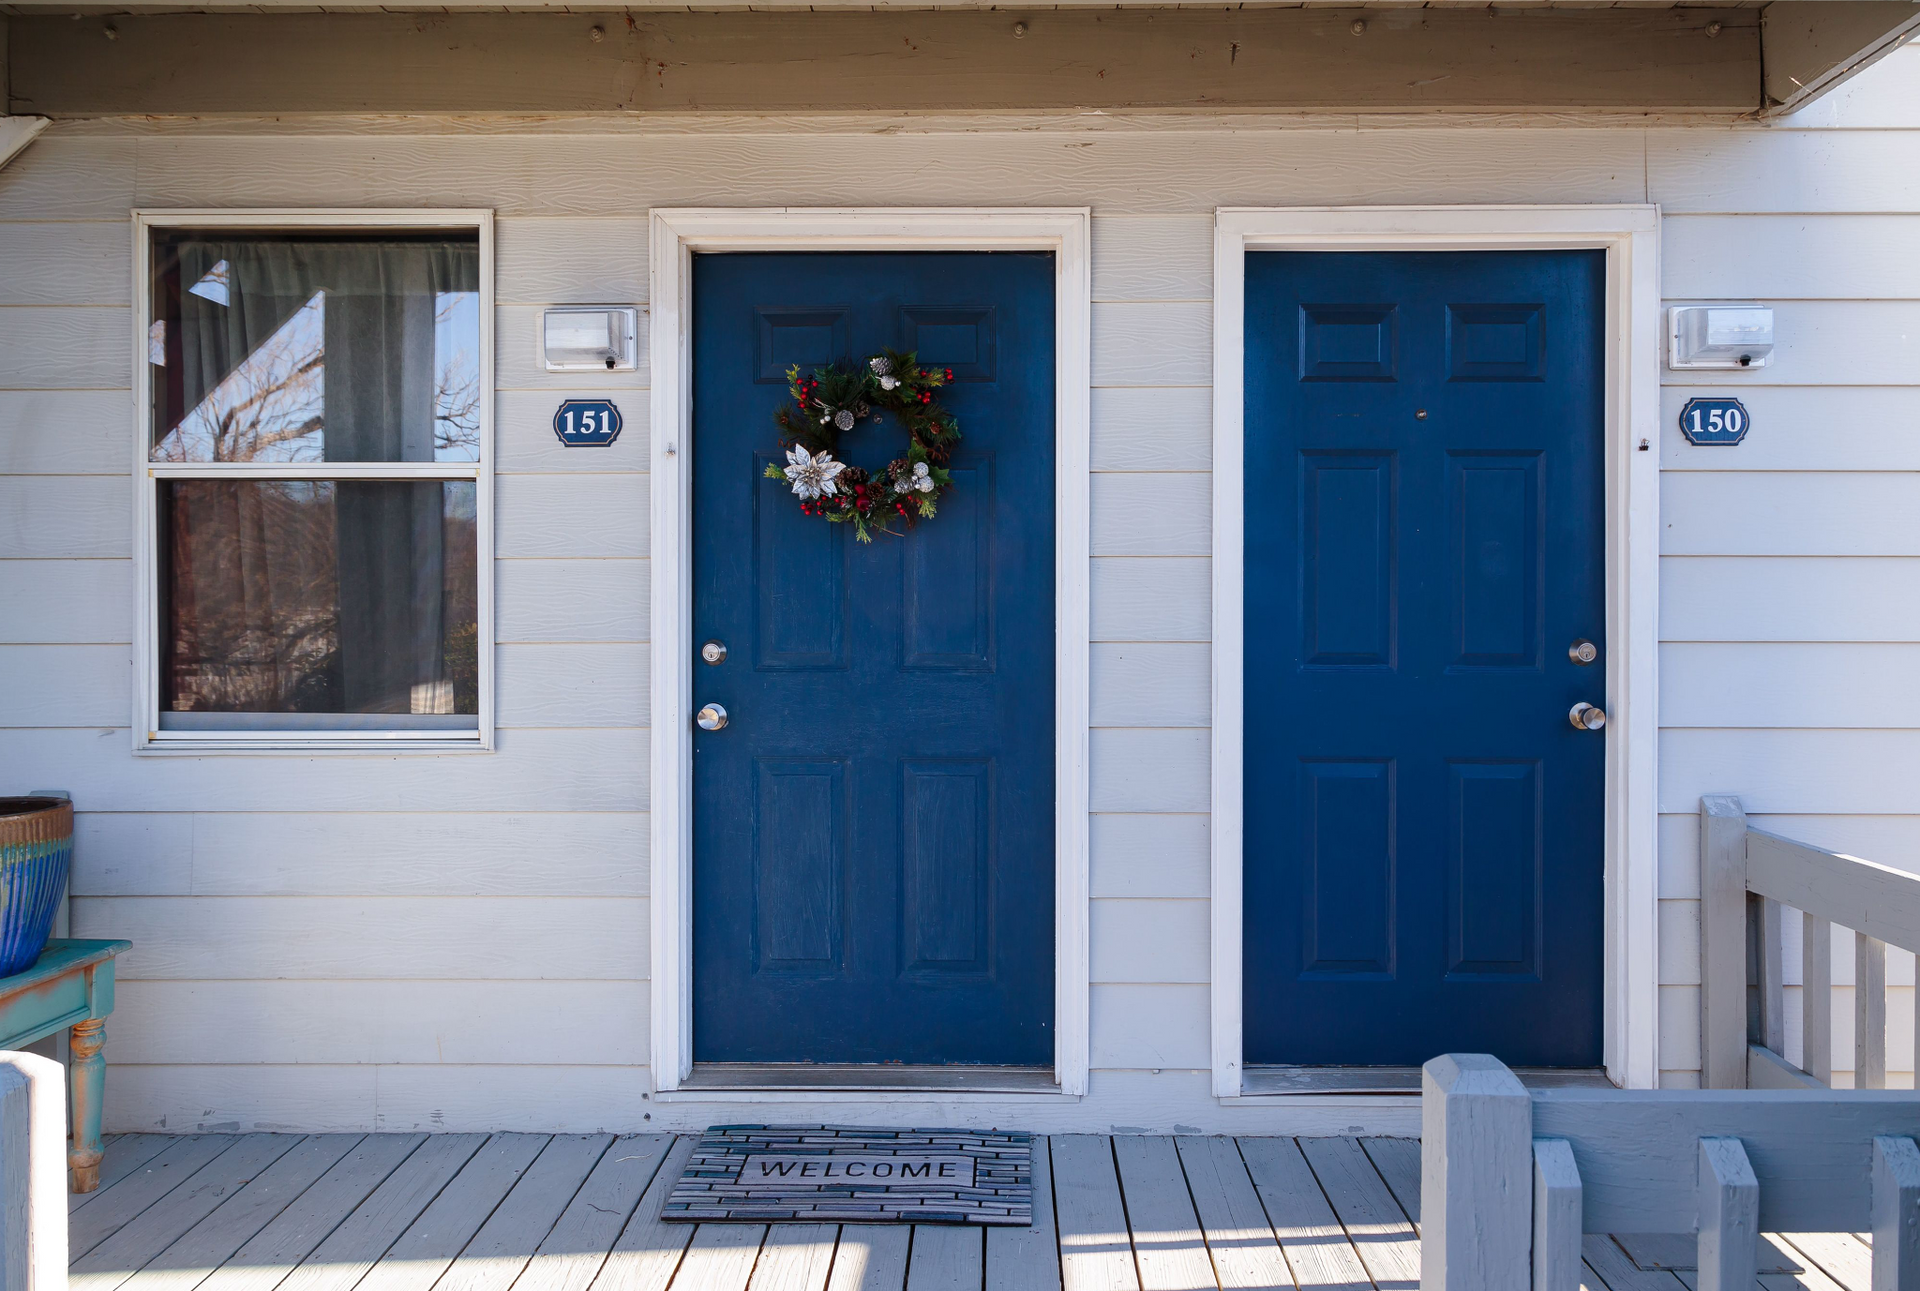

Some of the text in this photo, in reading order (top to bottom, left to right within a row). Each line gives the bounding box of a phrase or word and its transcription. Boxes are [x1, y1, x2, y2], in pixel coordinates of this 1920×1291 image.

[564, 410, 611, 434] 151
[1690, 408, 1742, 432] 150
[761, 1161, 957, 1178] WELCOME
